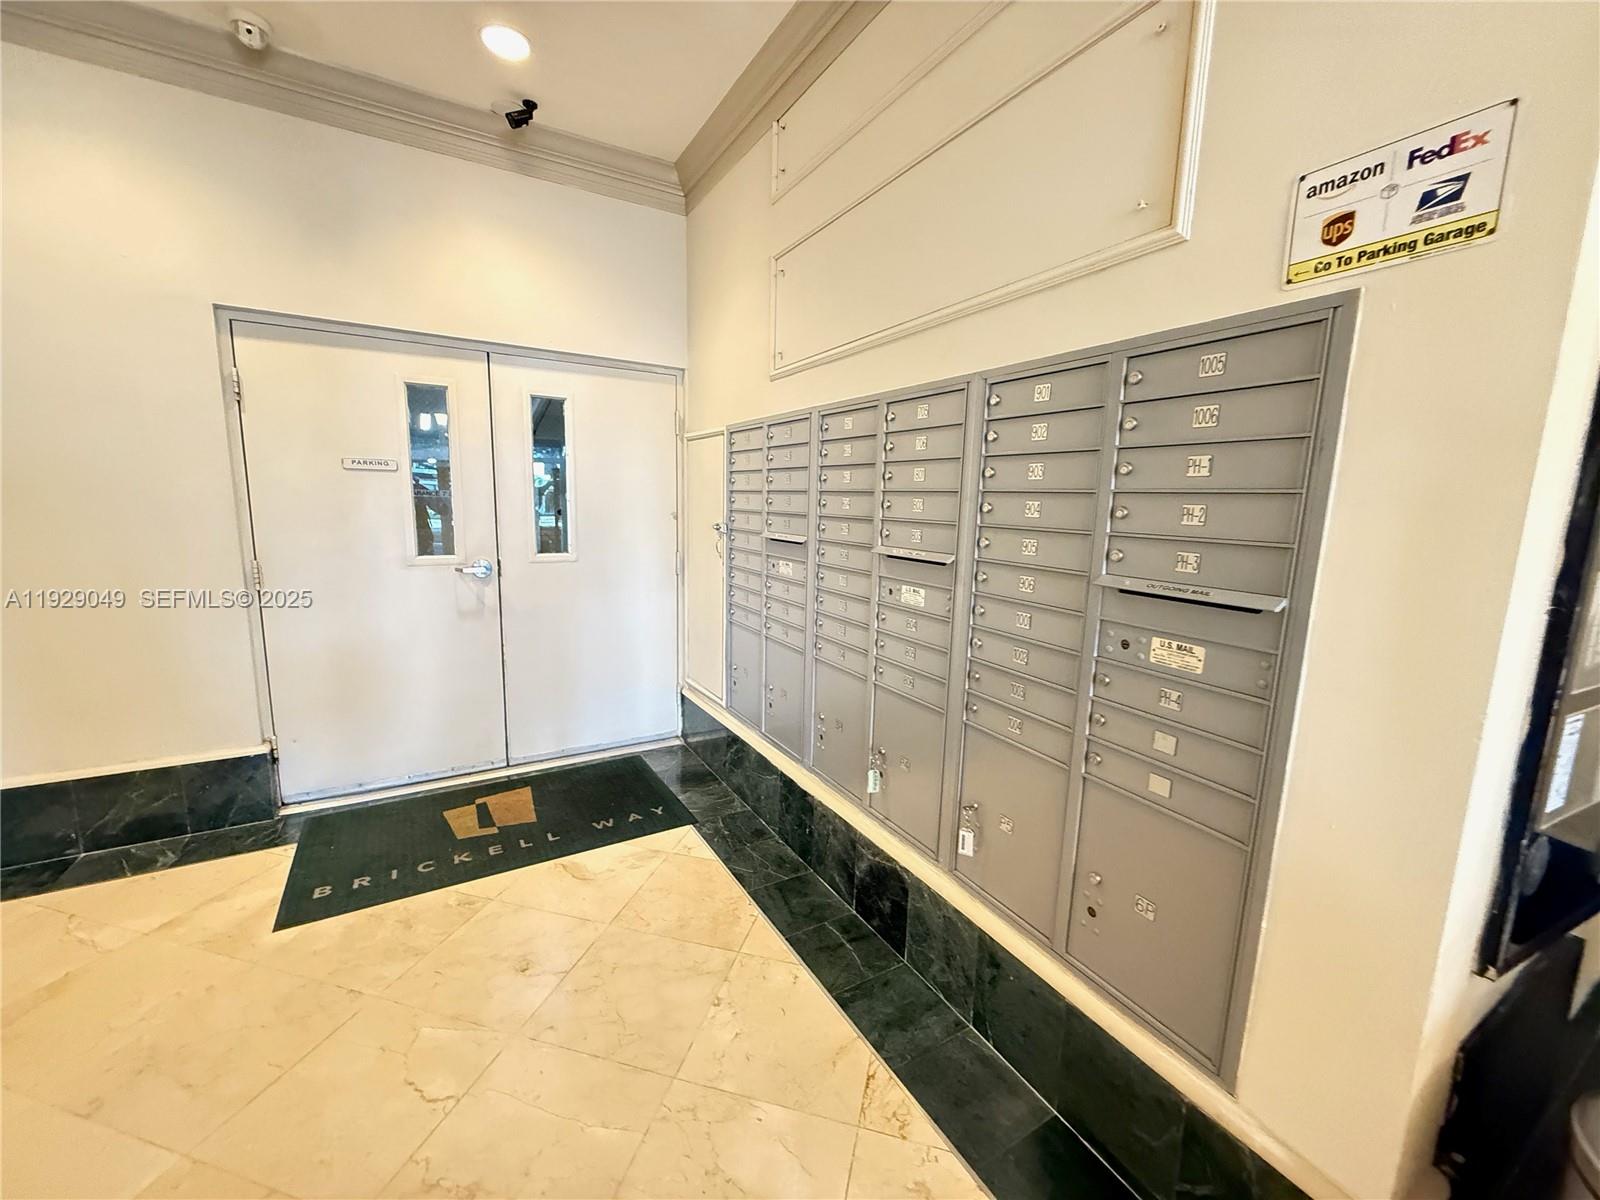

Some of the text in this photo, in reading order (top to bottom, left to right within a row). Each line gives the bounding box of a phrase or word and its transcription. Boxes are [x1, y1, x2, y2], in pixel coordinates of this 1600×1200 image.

[1406, 129, 1492, 170] FedEx
[1306, 161, 1386, 199] amazon
[1322, 218, 1353, 242] ups
[1313, 221, 1487, 274] Go To Parking Garage
[1199, 355, 1226, 376] 1005
[1035, 384, 1050, 401] 901
[1192, 407, 1219, 426] 1006
[1031, 424, 1047, 440] 902
[351, 458, 390, 467] PARKING
[1028, 464, 1044, 479] 903
[1187, 456, 1212, 475] PH-1
[1025, 502, 1041, 517] 904
[1182, 506, 1207, 524] PH-2
[1022, 540, 1038, 555] 905
[1176, 553, 1200, 572] PH-3
[1018, 576, 1035, 592] 906
[1146, 583, 1211, 597] OUTGOING MAIL
[1159, 640, 1197, 655] U.S. MAIL
[1160, 688, 1182, 709] PH-4
[311, 805, 667, 900] BRICKELL WAY
[1135, 897, 1156, 915] 6P
